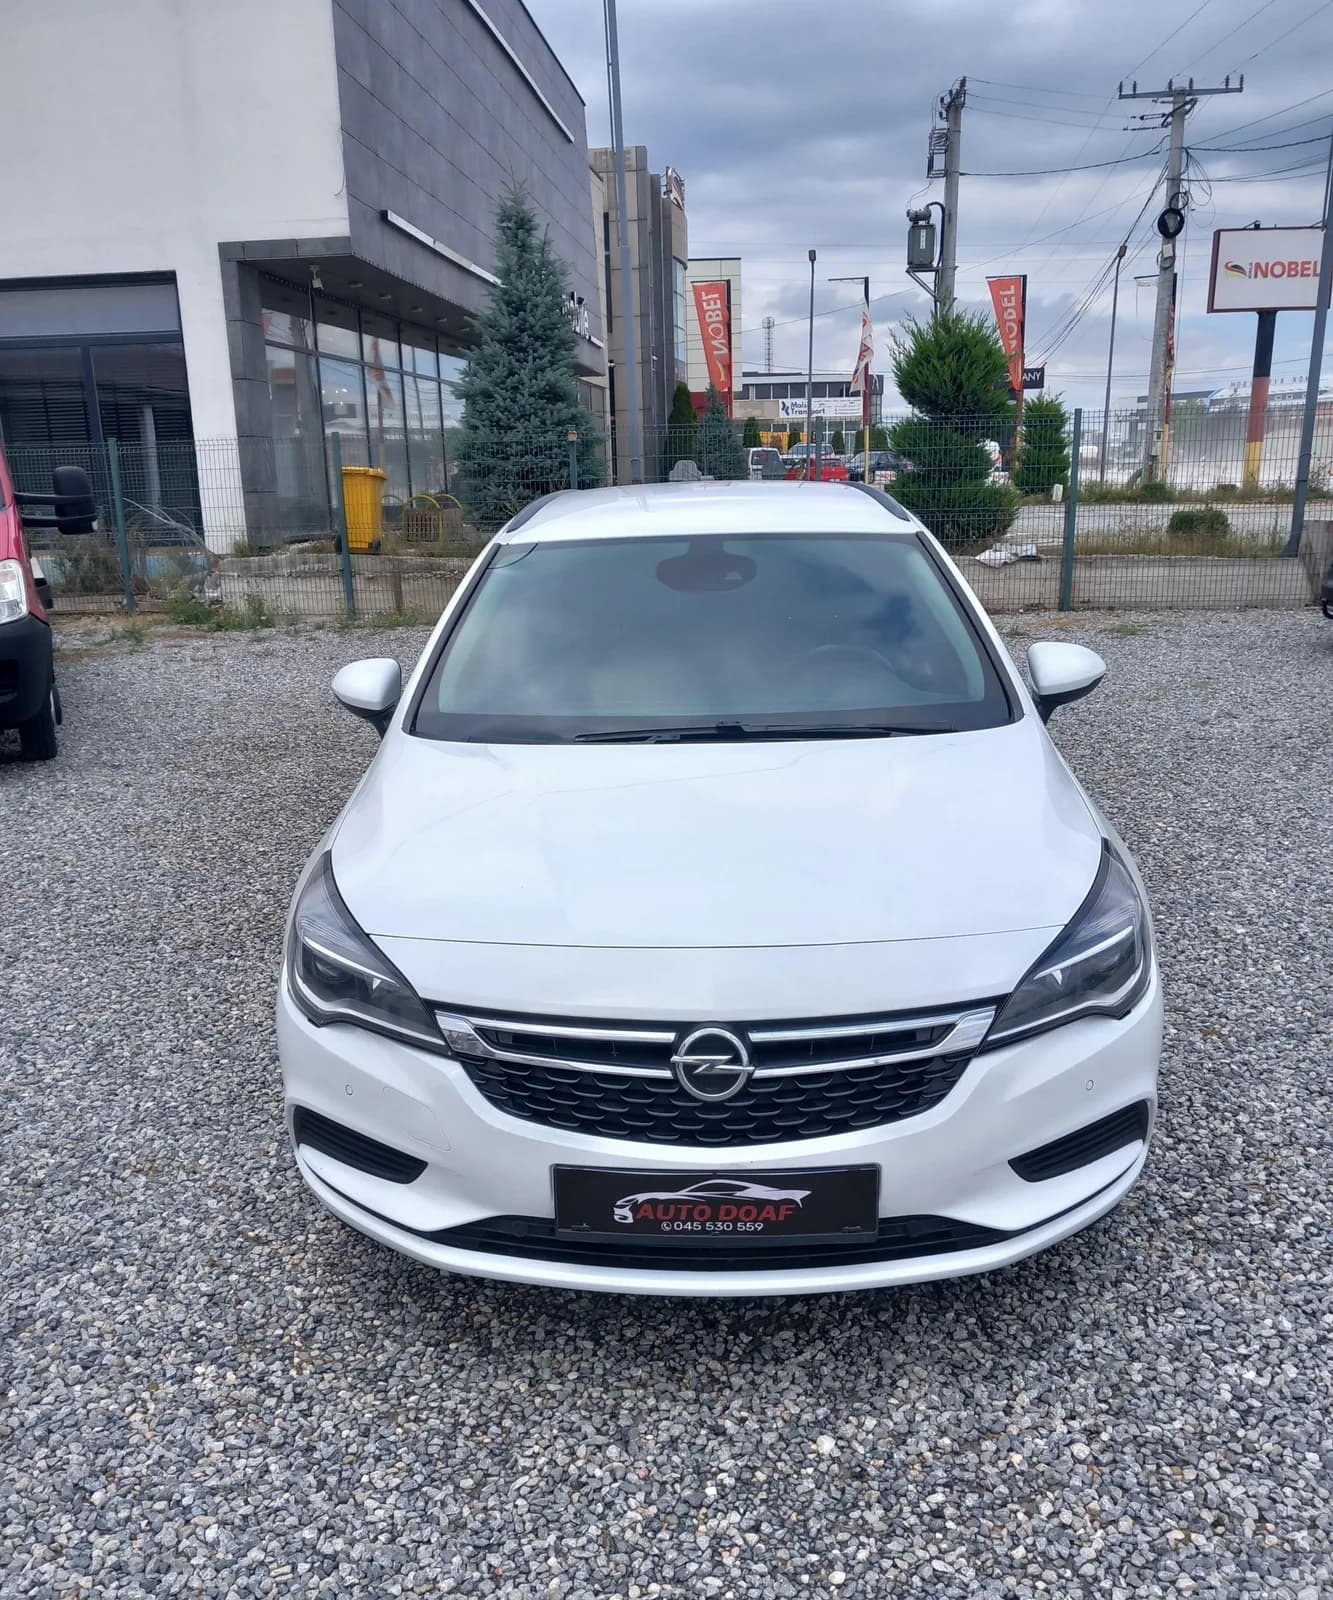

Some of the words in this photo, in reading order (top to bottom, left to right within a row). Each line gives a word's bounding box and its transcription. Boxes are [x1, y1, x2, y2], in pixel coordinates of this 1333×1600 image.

[1253, 261, 1320, 279] NOBEL
[636, 1203, 712, 1221] AUTO
[718, 1204, 797, 1221] DOAF
[673, 1222, 702, 1231] 045
[705, 1222, 733, 1231] 530
[736, 1222, 764, 1232] 559
